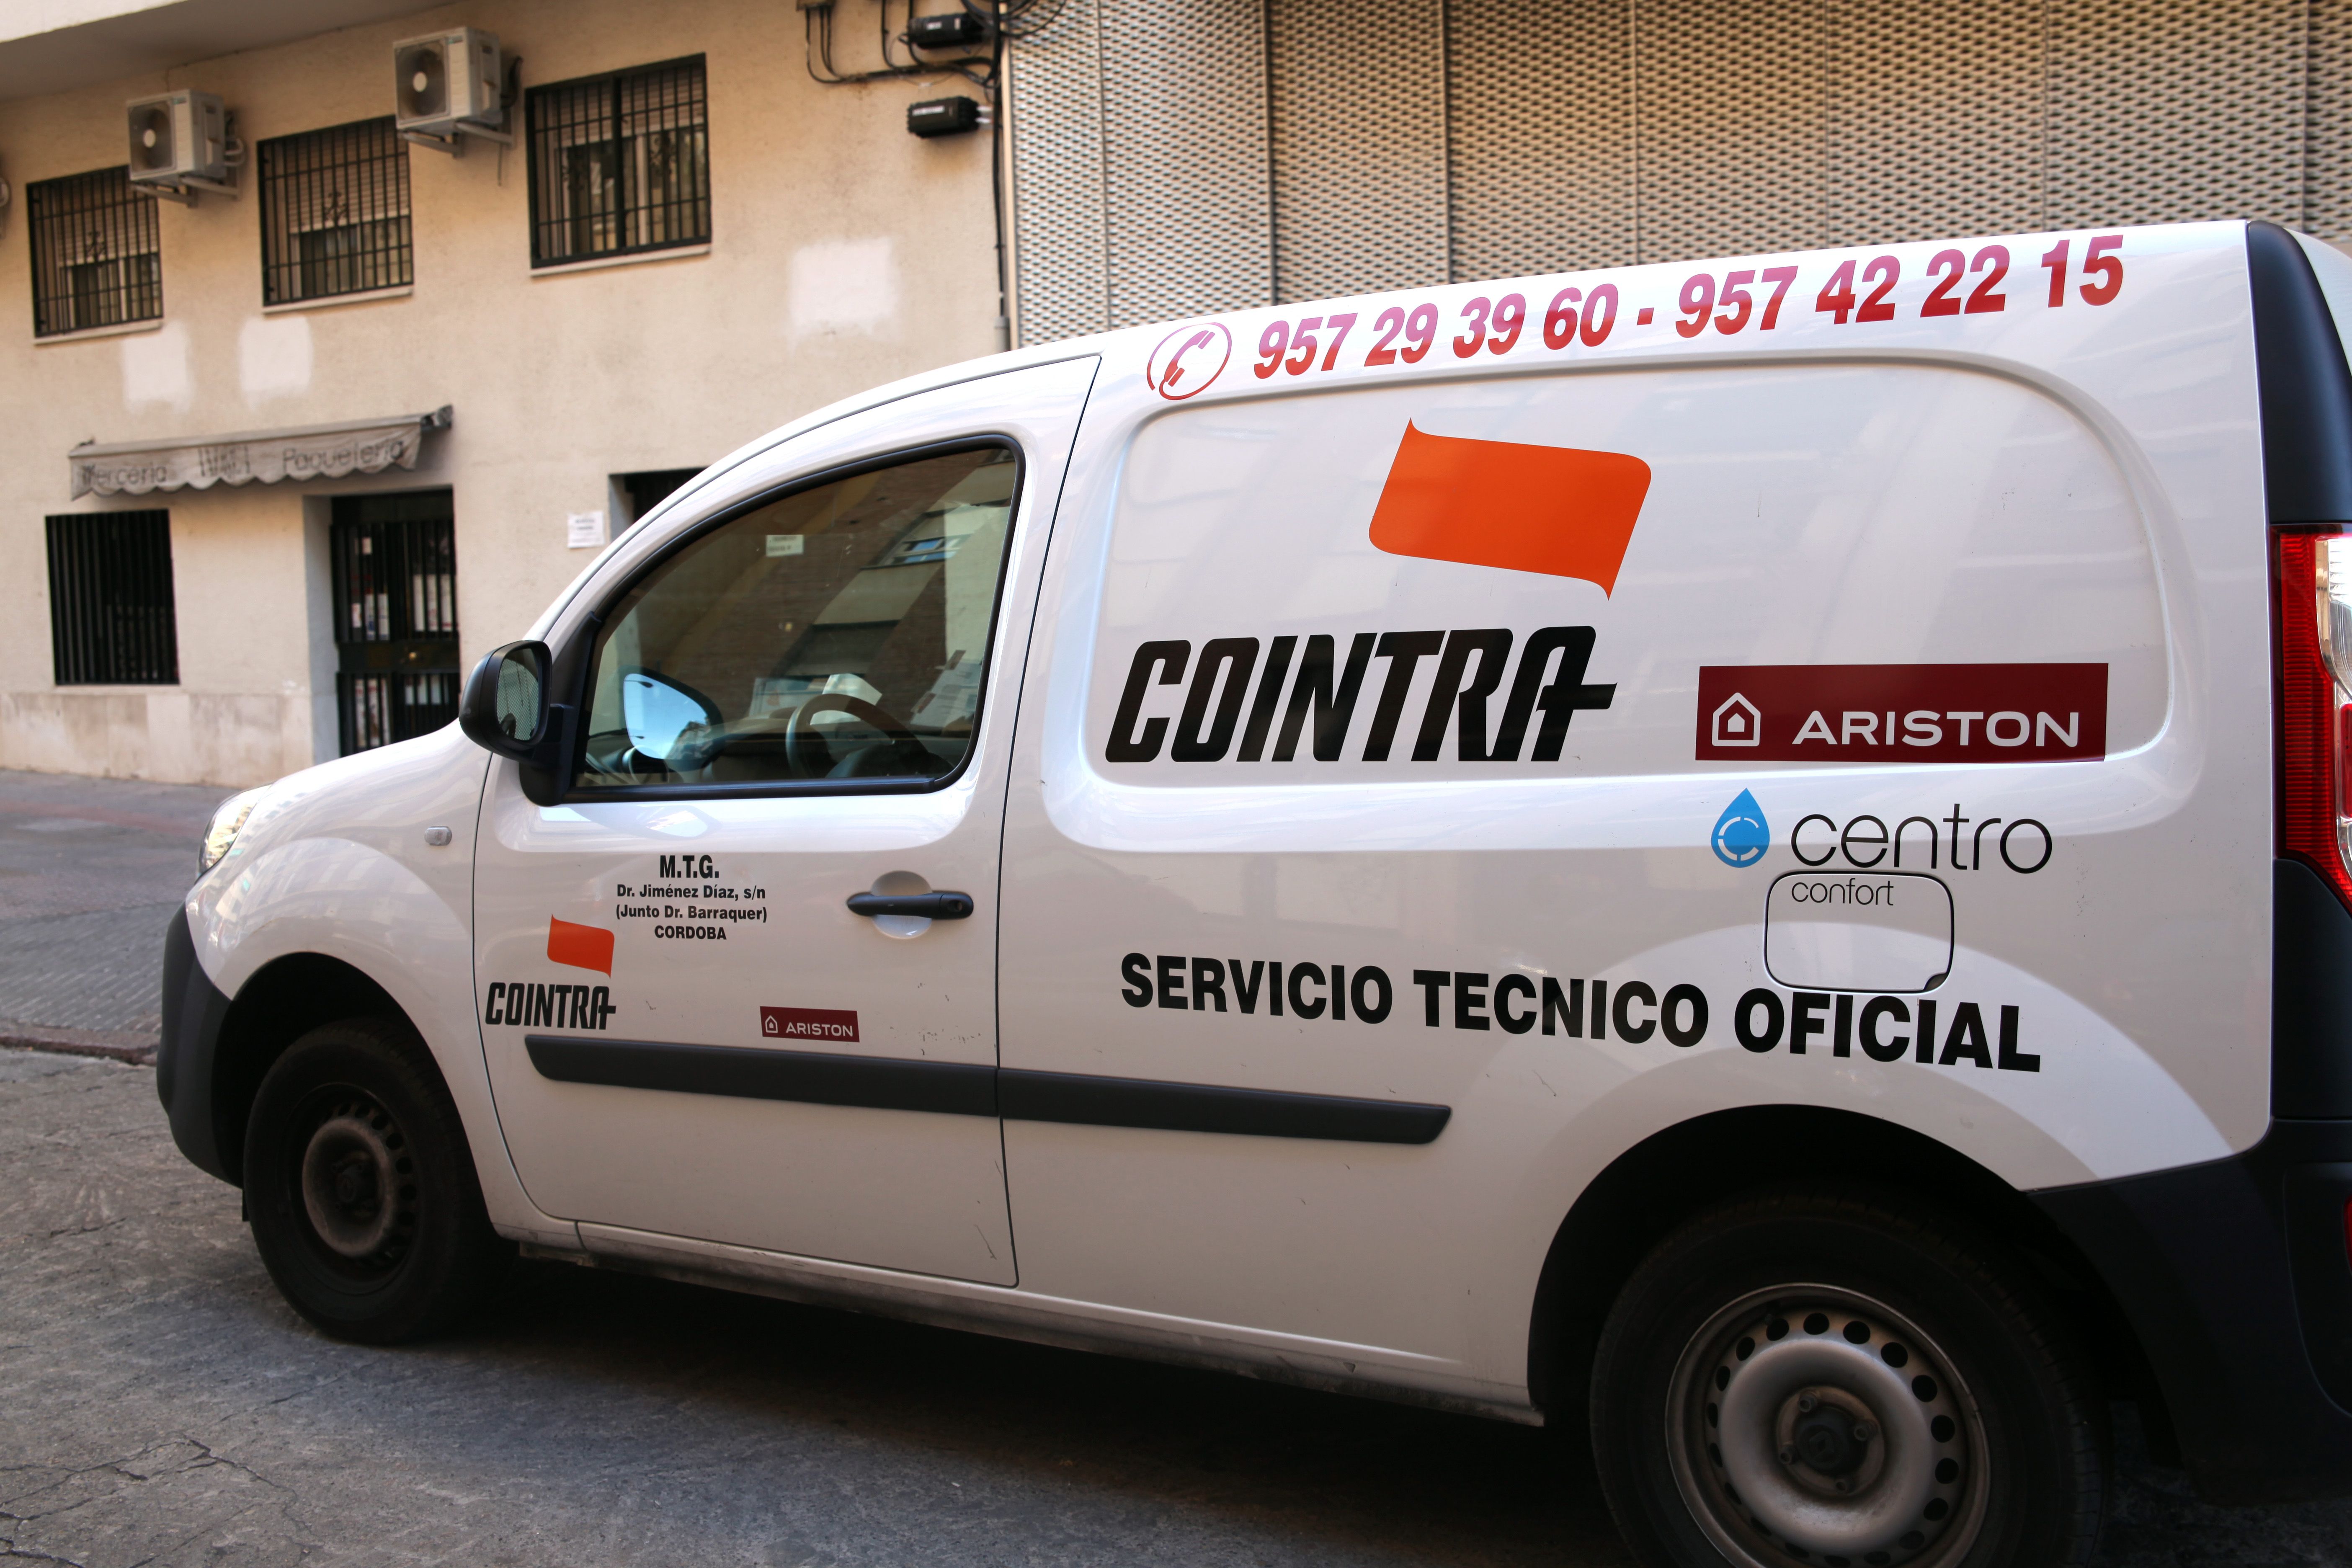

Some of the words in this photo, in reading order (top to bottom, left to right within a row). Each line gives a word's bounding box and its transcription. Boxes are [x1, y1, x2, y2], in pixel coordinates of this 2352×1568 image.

[1253, 312, 1358, 379] 957
[1364, 303, 1438, 367] 29
[1452, 293, 1526, 359] 39
[1543, 283, 1619, 351] 60
[1675, 265, 1798, 338] 957
[1815, 255, 1901, 325] 42
[1919, 245, 2010, 318] 22
[2041, 234, 2124, 308] 15
[1104, 625, 1618, 763] COINTRA
[1791, 710, 2079, 748] ARISTON
[1790, 803, 2053, 874] centro
[659, 854, 720, 879] M.T.G.
[616, 884, 635, 897] Dr.
[639, 884, 699, 898] Jiménez
[703, 885, 739, 902] Díaz,
[743, 885, 766, 900] s/n
[1791, 877, 1894, 906] confort
[616, 904, 660, 920] (Junto
[664, 905, 683, 919] Dr.
[688, 905, 767, 923] Barraquer)
[654, 925, 727, 941] CORDOBA
[485, 982, 617, 1030] COINTRA
[1121, 952, 1393, 1024] SERVICIO
[1413, 968, 1709, 1048] TECNICO
[1734, 988, 2041, 1073] OFICIAL
[785, 1021, 854, 1037] ARISTON
